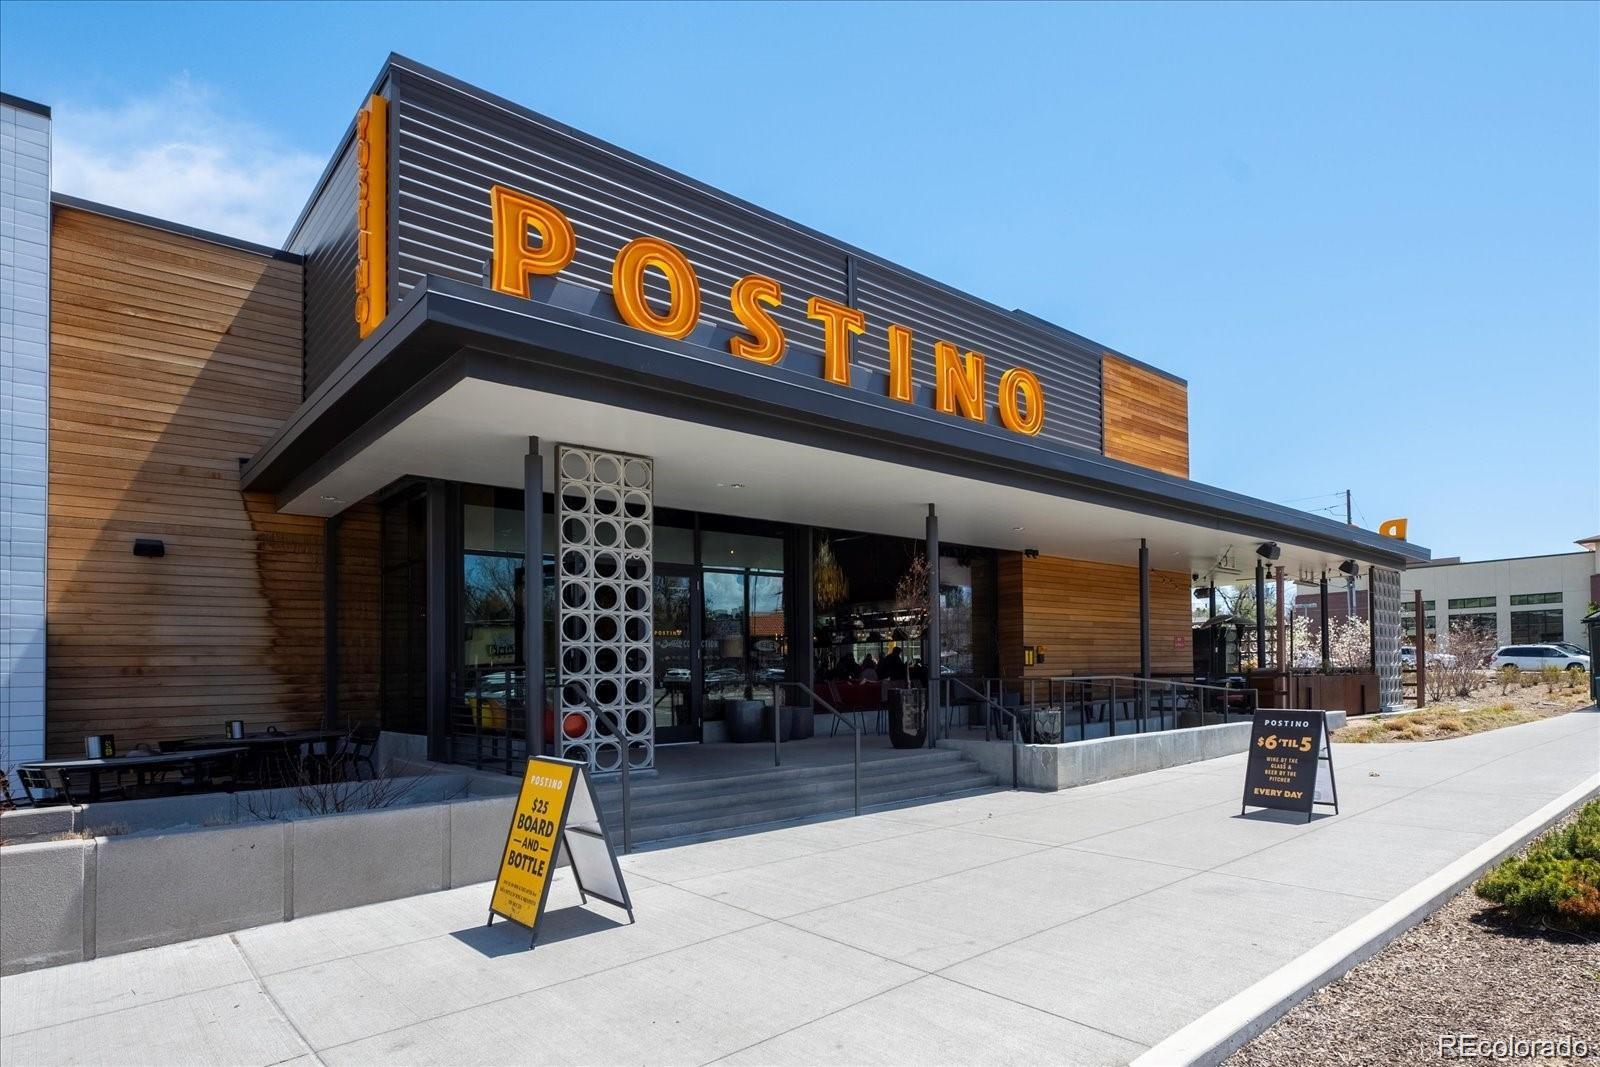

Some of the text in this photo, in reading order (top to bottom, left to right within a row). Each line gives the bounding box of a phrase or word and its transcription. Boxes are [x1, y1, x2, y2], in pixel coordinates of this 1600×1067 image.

[490, 185, 1045, 437] POSTINO
[1264, 719, 1309, 728] POSTINO
[1257, 734, 1278, 750] $6
[1299, 736, 1312, 752] 5
[530, 775, 563, 790] POSTINO
[1253, 787, 1303, 799] EVERY DAY
[532, 797, 549, 814] $25
[517, 813, 554, 837] BOARD
[522, 837, 539, 852] AND
[508, 850, 545, 877] BOTTLE
